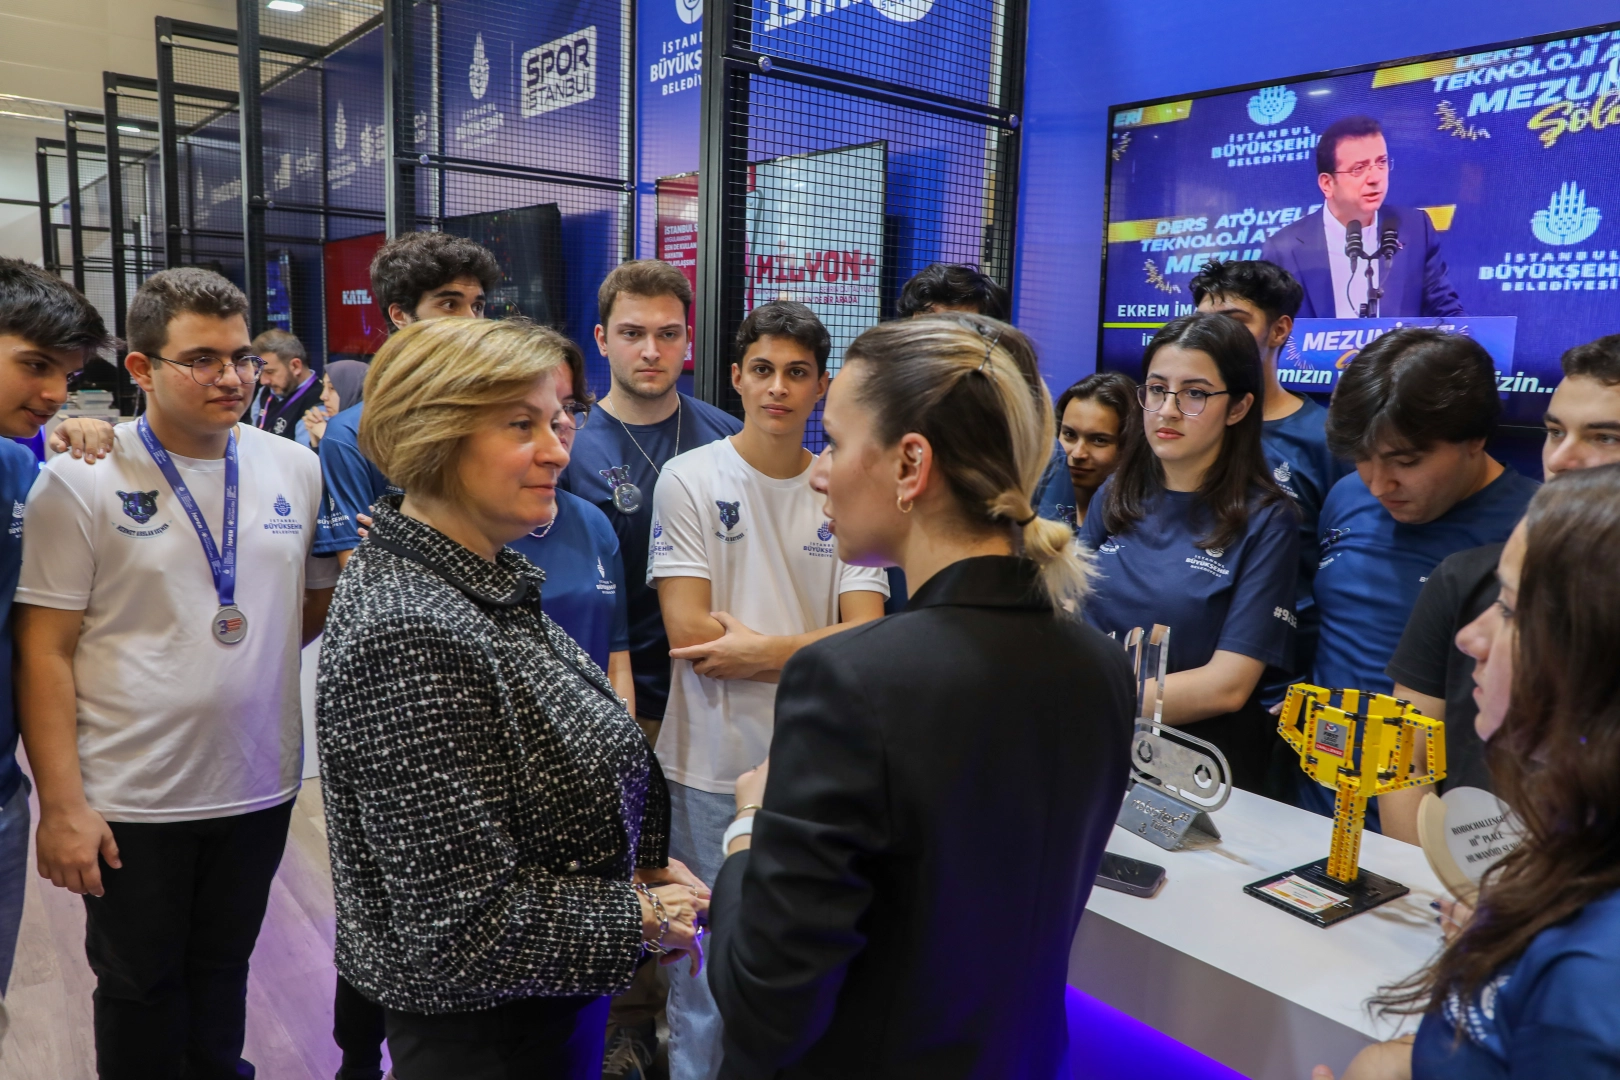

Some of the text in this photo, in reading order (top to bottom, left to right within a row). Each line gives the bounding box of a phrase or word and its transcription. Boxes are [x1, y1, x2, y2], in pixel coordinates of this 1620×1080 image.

[526, 37, 590, 88] SPOR
[1229, 126, 1311, 143] İSTANBUL
[1228, 150, 1310, 168] BELEDİYESİ
[1156, 217, 1208, 236] DERS
[1141, 222, 1292, 252] TEKNOLOJİ AT
[1505, 249, 1620, 264] İSTANBUL
[1479, 261, 1620, 281] BÜYÜKŞEH
[1502, 278, 1618, 292] BELEDİYESİ
[1117, 304, 1170, 317] EKREM
[1481, 831, 1505, 844] PLACE
[1465, 847, 1502, 864] HUMANOID
